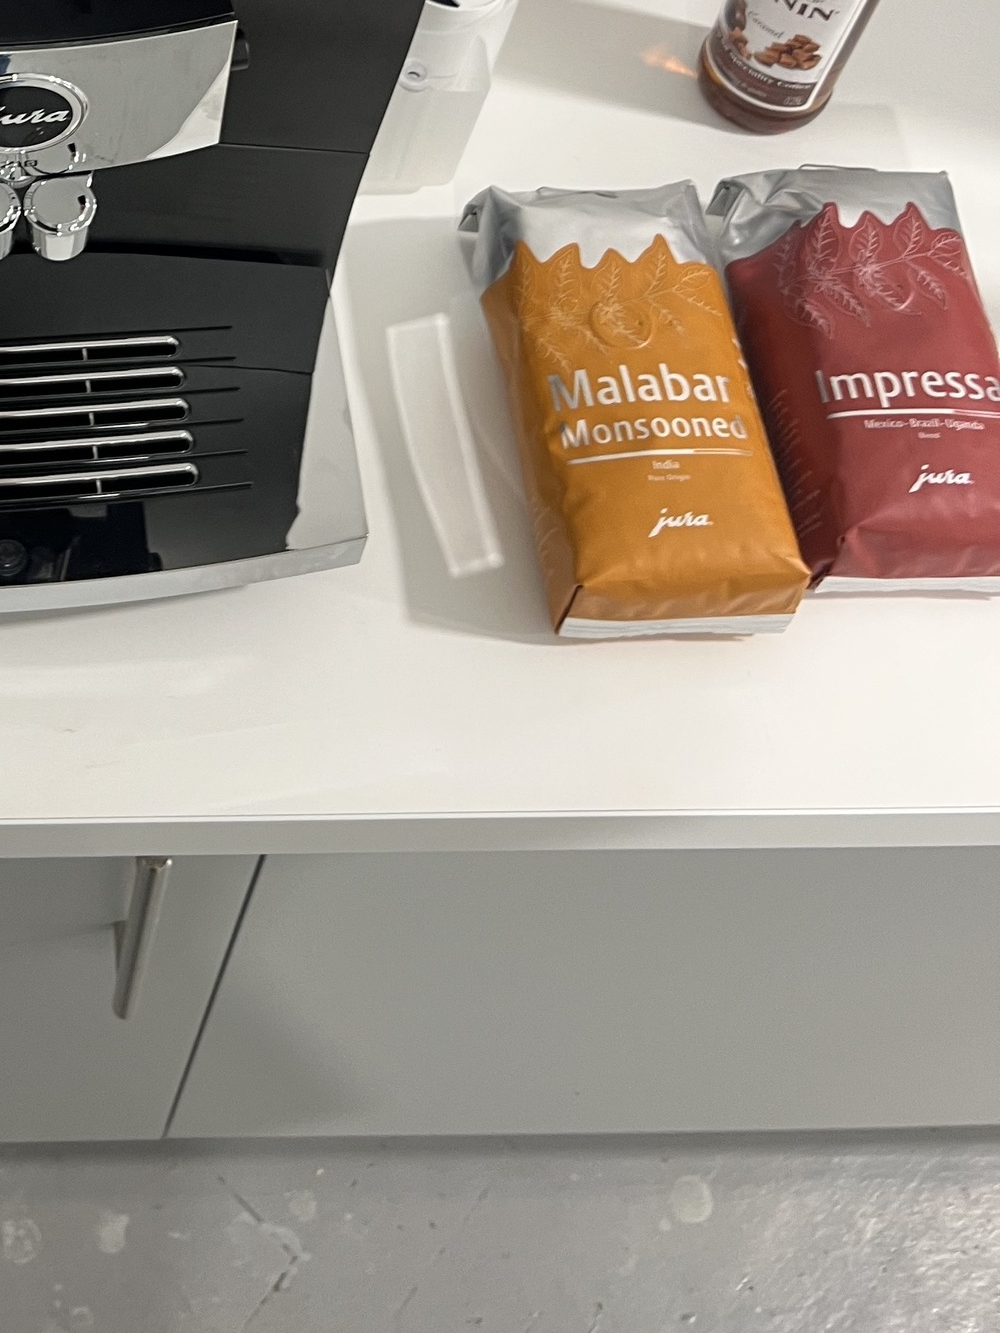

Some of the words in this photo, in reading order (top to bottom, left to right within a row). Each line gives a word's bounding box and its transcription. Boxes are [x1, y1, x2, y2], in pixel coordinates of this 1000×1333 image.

[547, 363, 731, 412] Malabar
[815, 369, 1000, 408] Impressa
[560, 415, 748, 450] Monsooned
[652, 459, 681, 470] India
[908, 464, 972, 493] jura
[648, 508, 711, 538] jura
